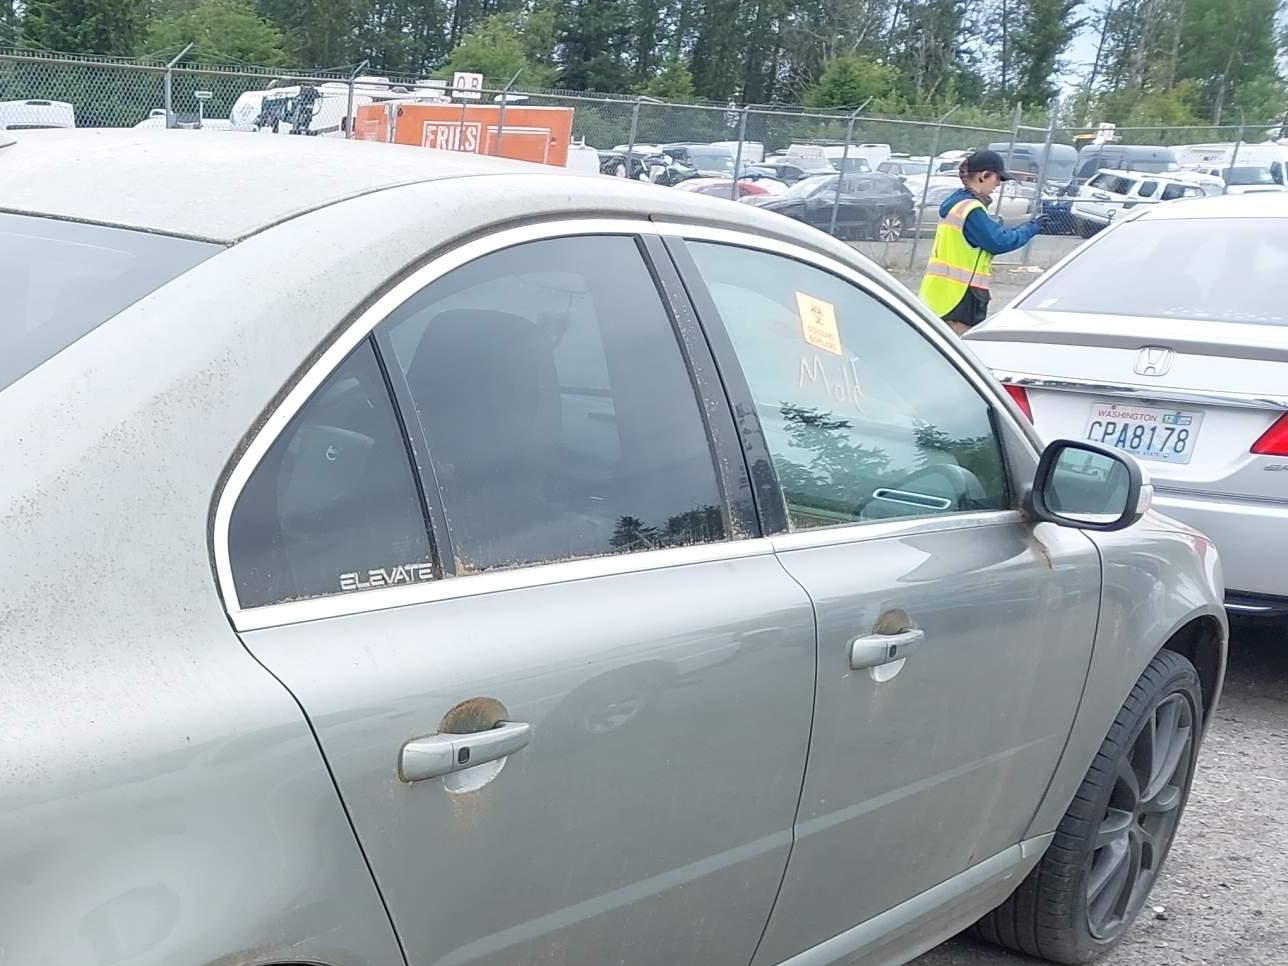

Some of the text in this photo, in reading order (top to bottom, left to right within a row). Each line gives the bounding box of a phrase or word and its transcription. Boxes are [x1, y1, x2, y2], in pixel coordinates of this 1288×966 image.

[1098, 408, 1158, 422] WASHINGTON
[1087, 420, 1189, 454] CPA8178
[340, 562, 433, 591] ELEVATE
